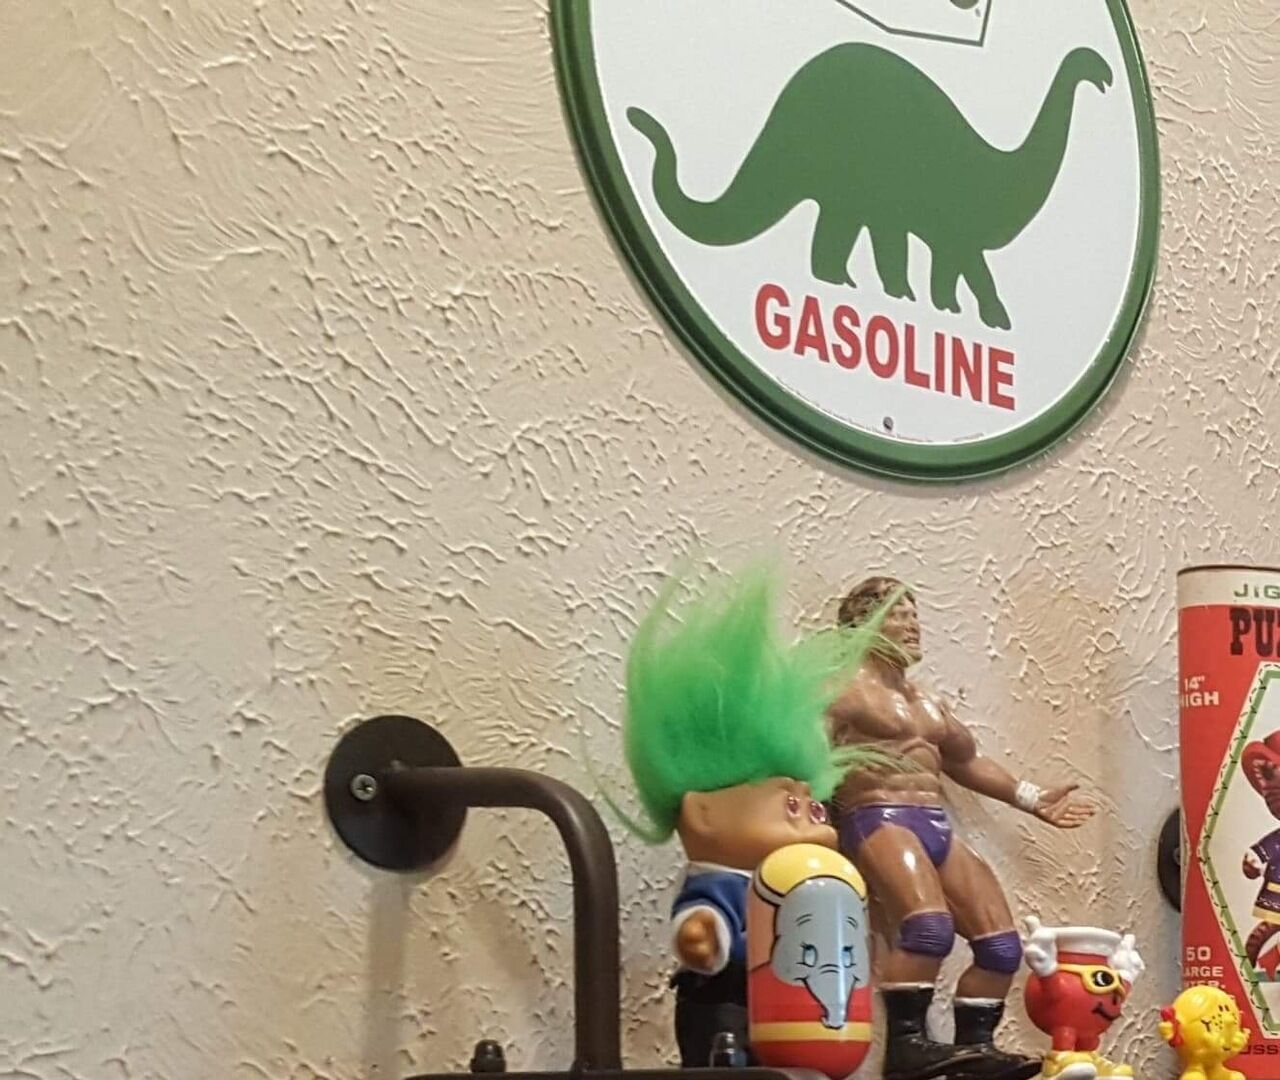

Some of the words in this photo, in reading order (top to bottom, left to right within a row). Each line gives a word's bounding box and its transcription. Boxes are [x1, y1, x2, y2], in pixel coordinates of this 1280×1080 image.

[754, 283, 1016, 412] GASOLINE
[1185, 945, 1212, 961] 50
[1183, 965, 1224, 977] ARGE
